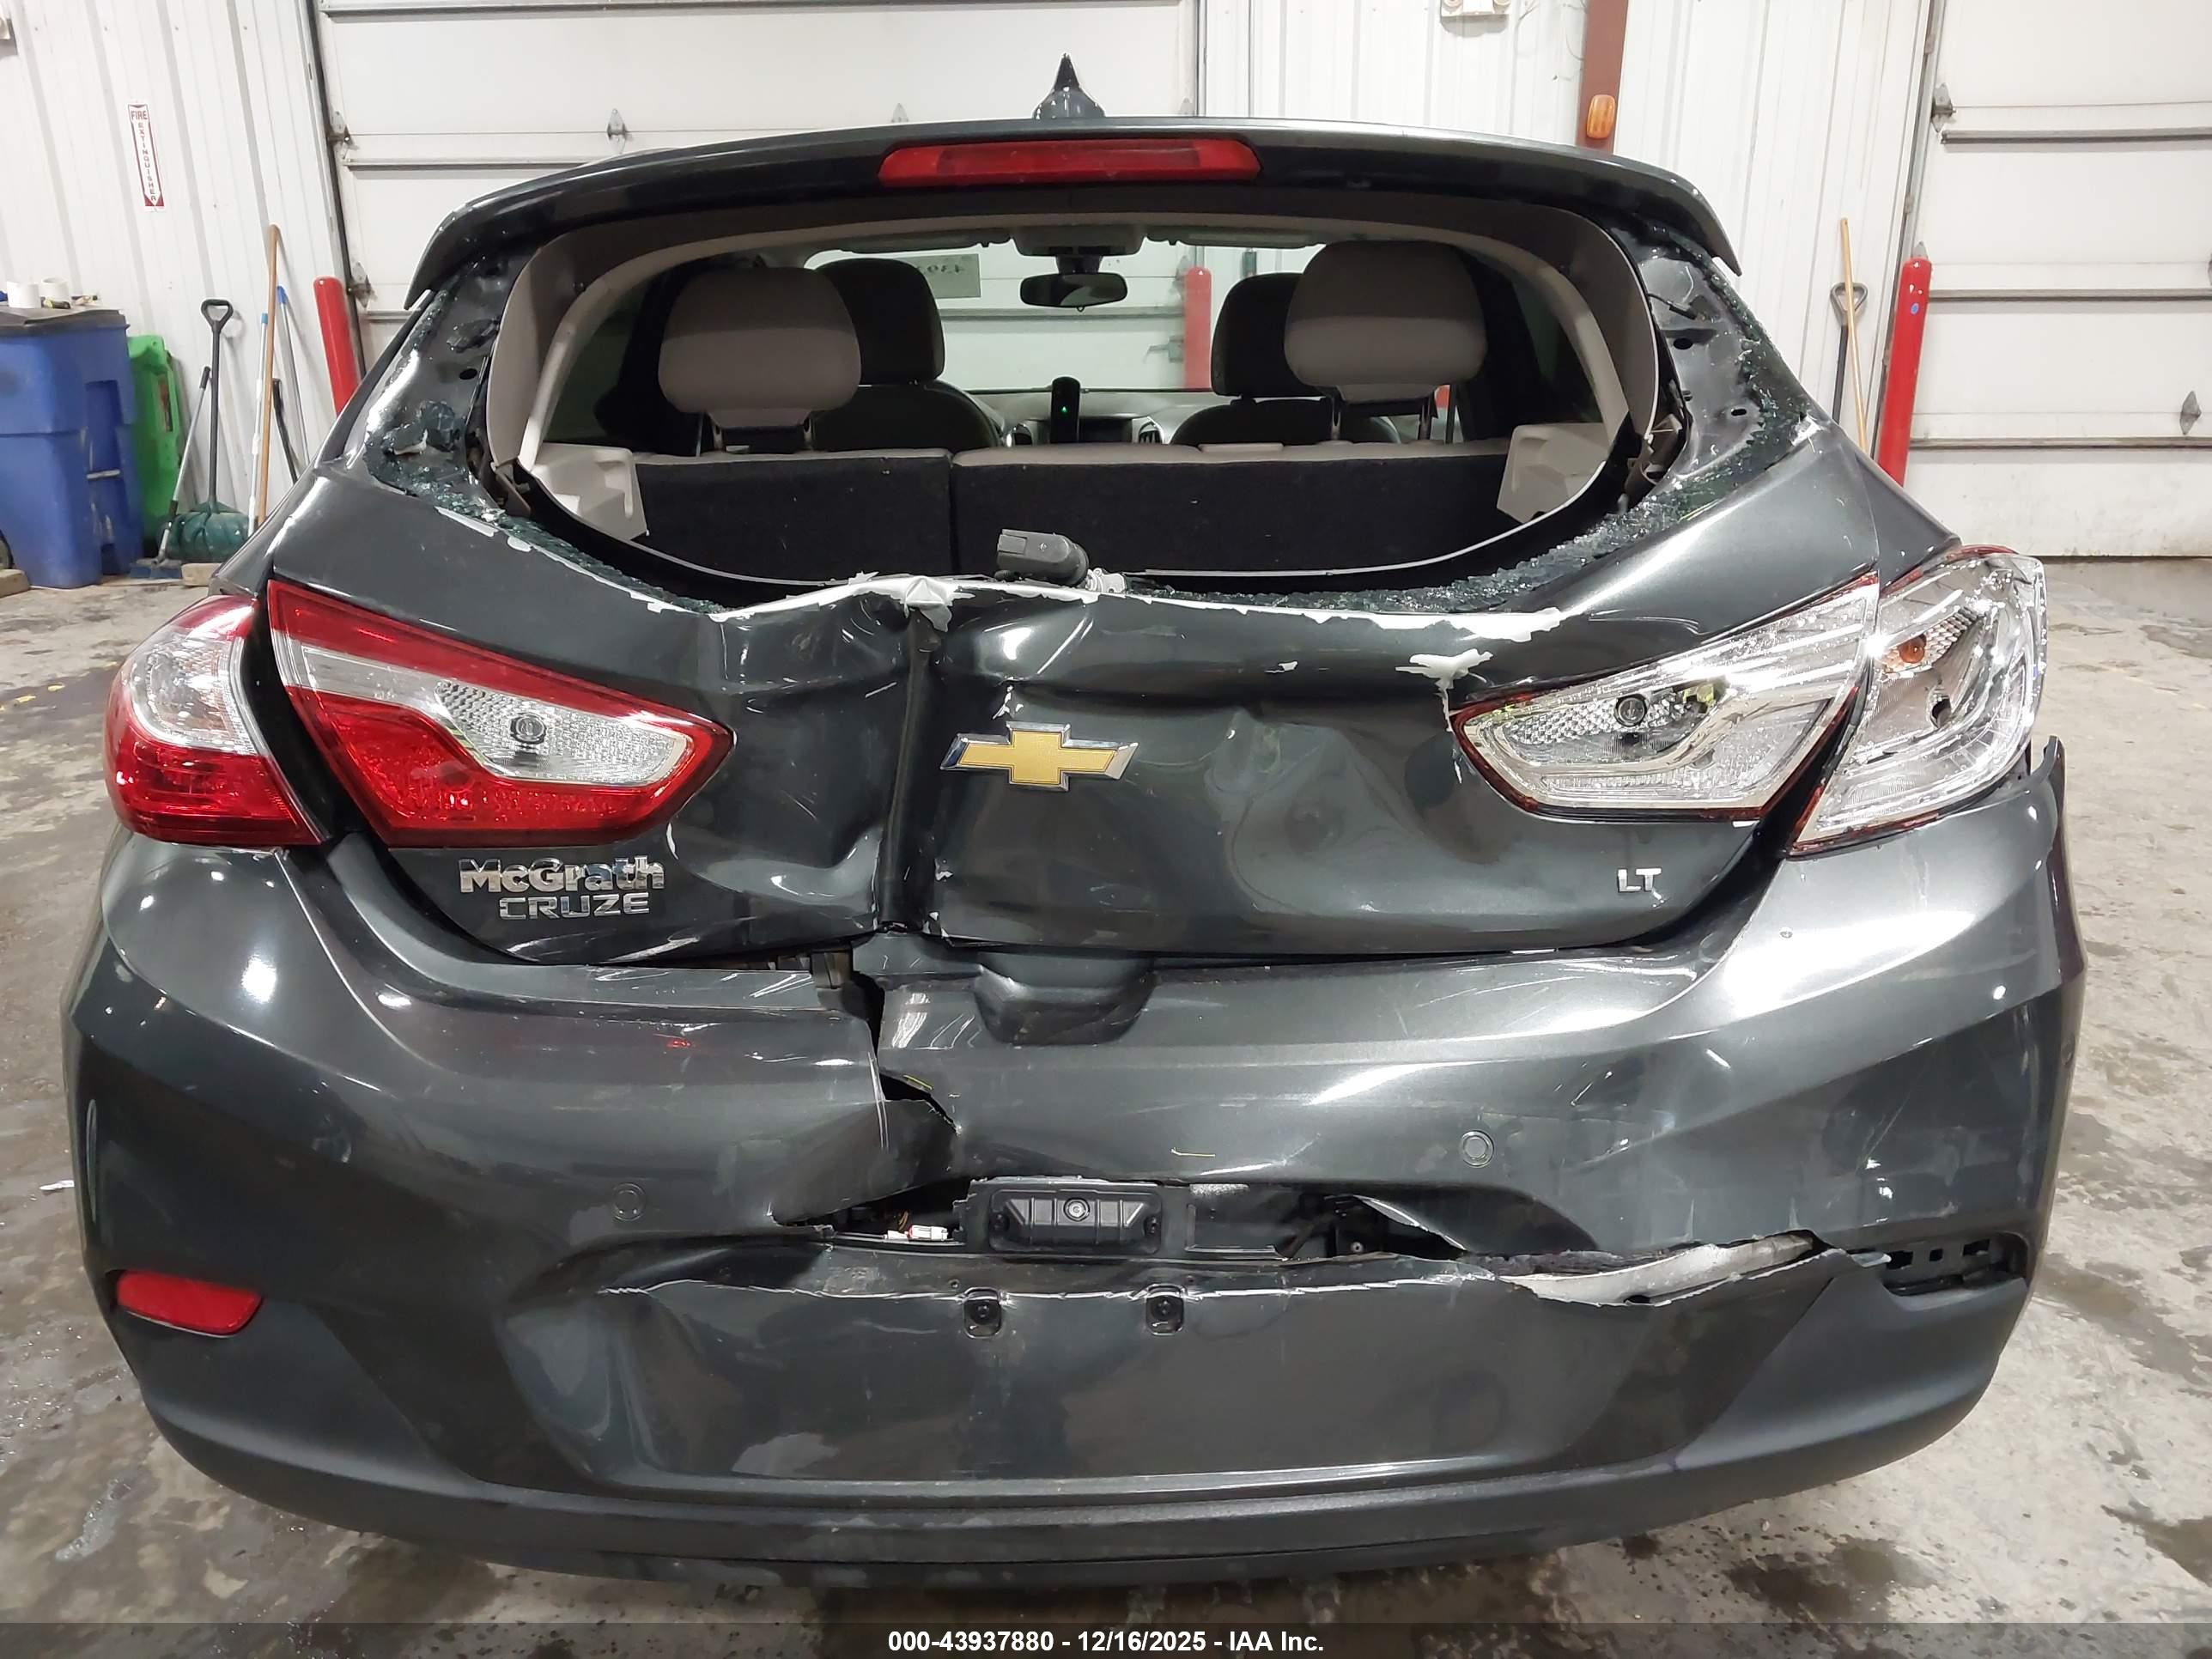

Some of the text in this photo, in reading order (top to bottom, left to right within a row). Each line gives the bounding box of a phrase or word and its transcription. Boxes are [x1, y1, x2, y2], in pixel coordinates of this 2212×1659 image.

[131, 110, 148, 120] FIRE
[137, 122, 156, 201] EXTINGUISHER
[458, 855, 665, 893] McGrath
[1618, 868, 1662, 892] LT
[499, 892, 650, 920] CRUZE
